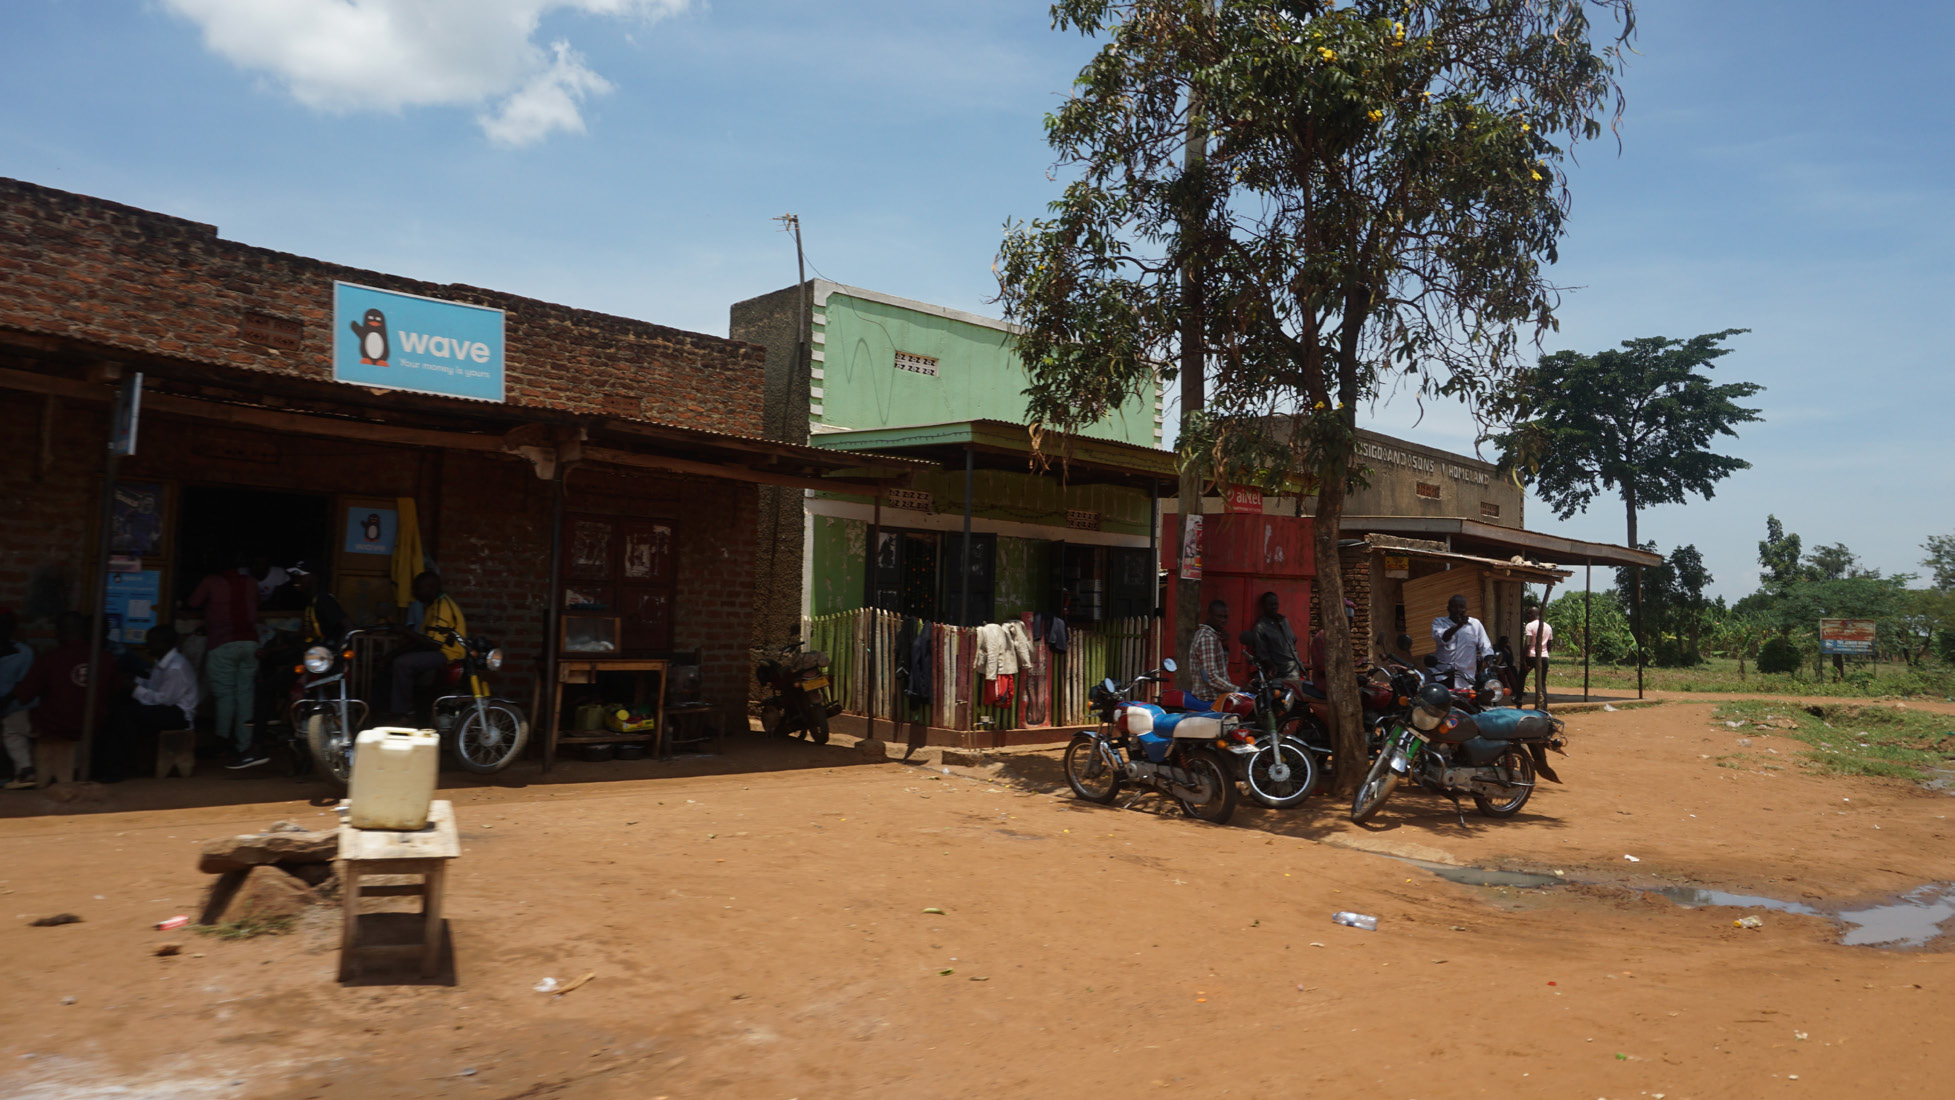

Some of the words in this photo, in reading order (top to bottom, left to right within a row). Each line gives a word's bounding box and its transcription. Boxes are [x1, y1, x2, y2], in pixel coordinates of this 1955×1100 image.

[398, 330, 490, 363] wave
[422, 363, 454, 375] money
[1236, 489, 1261, 505] airtel
